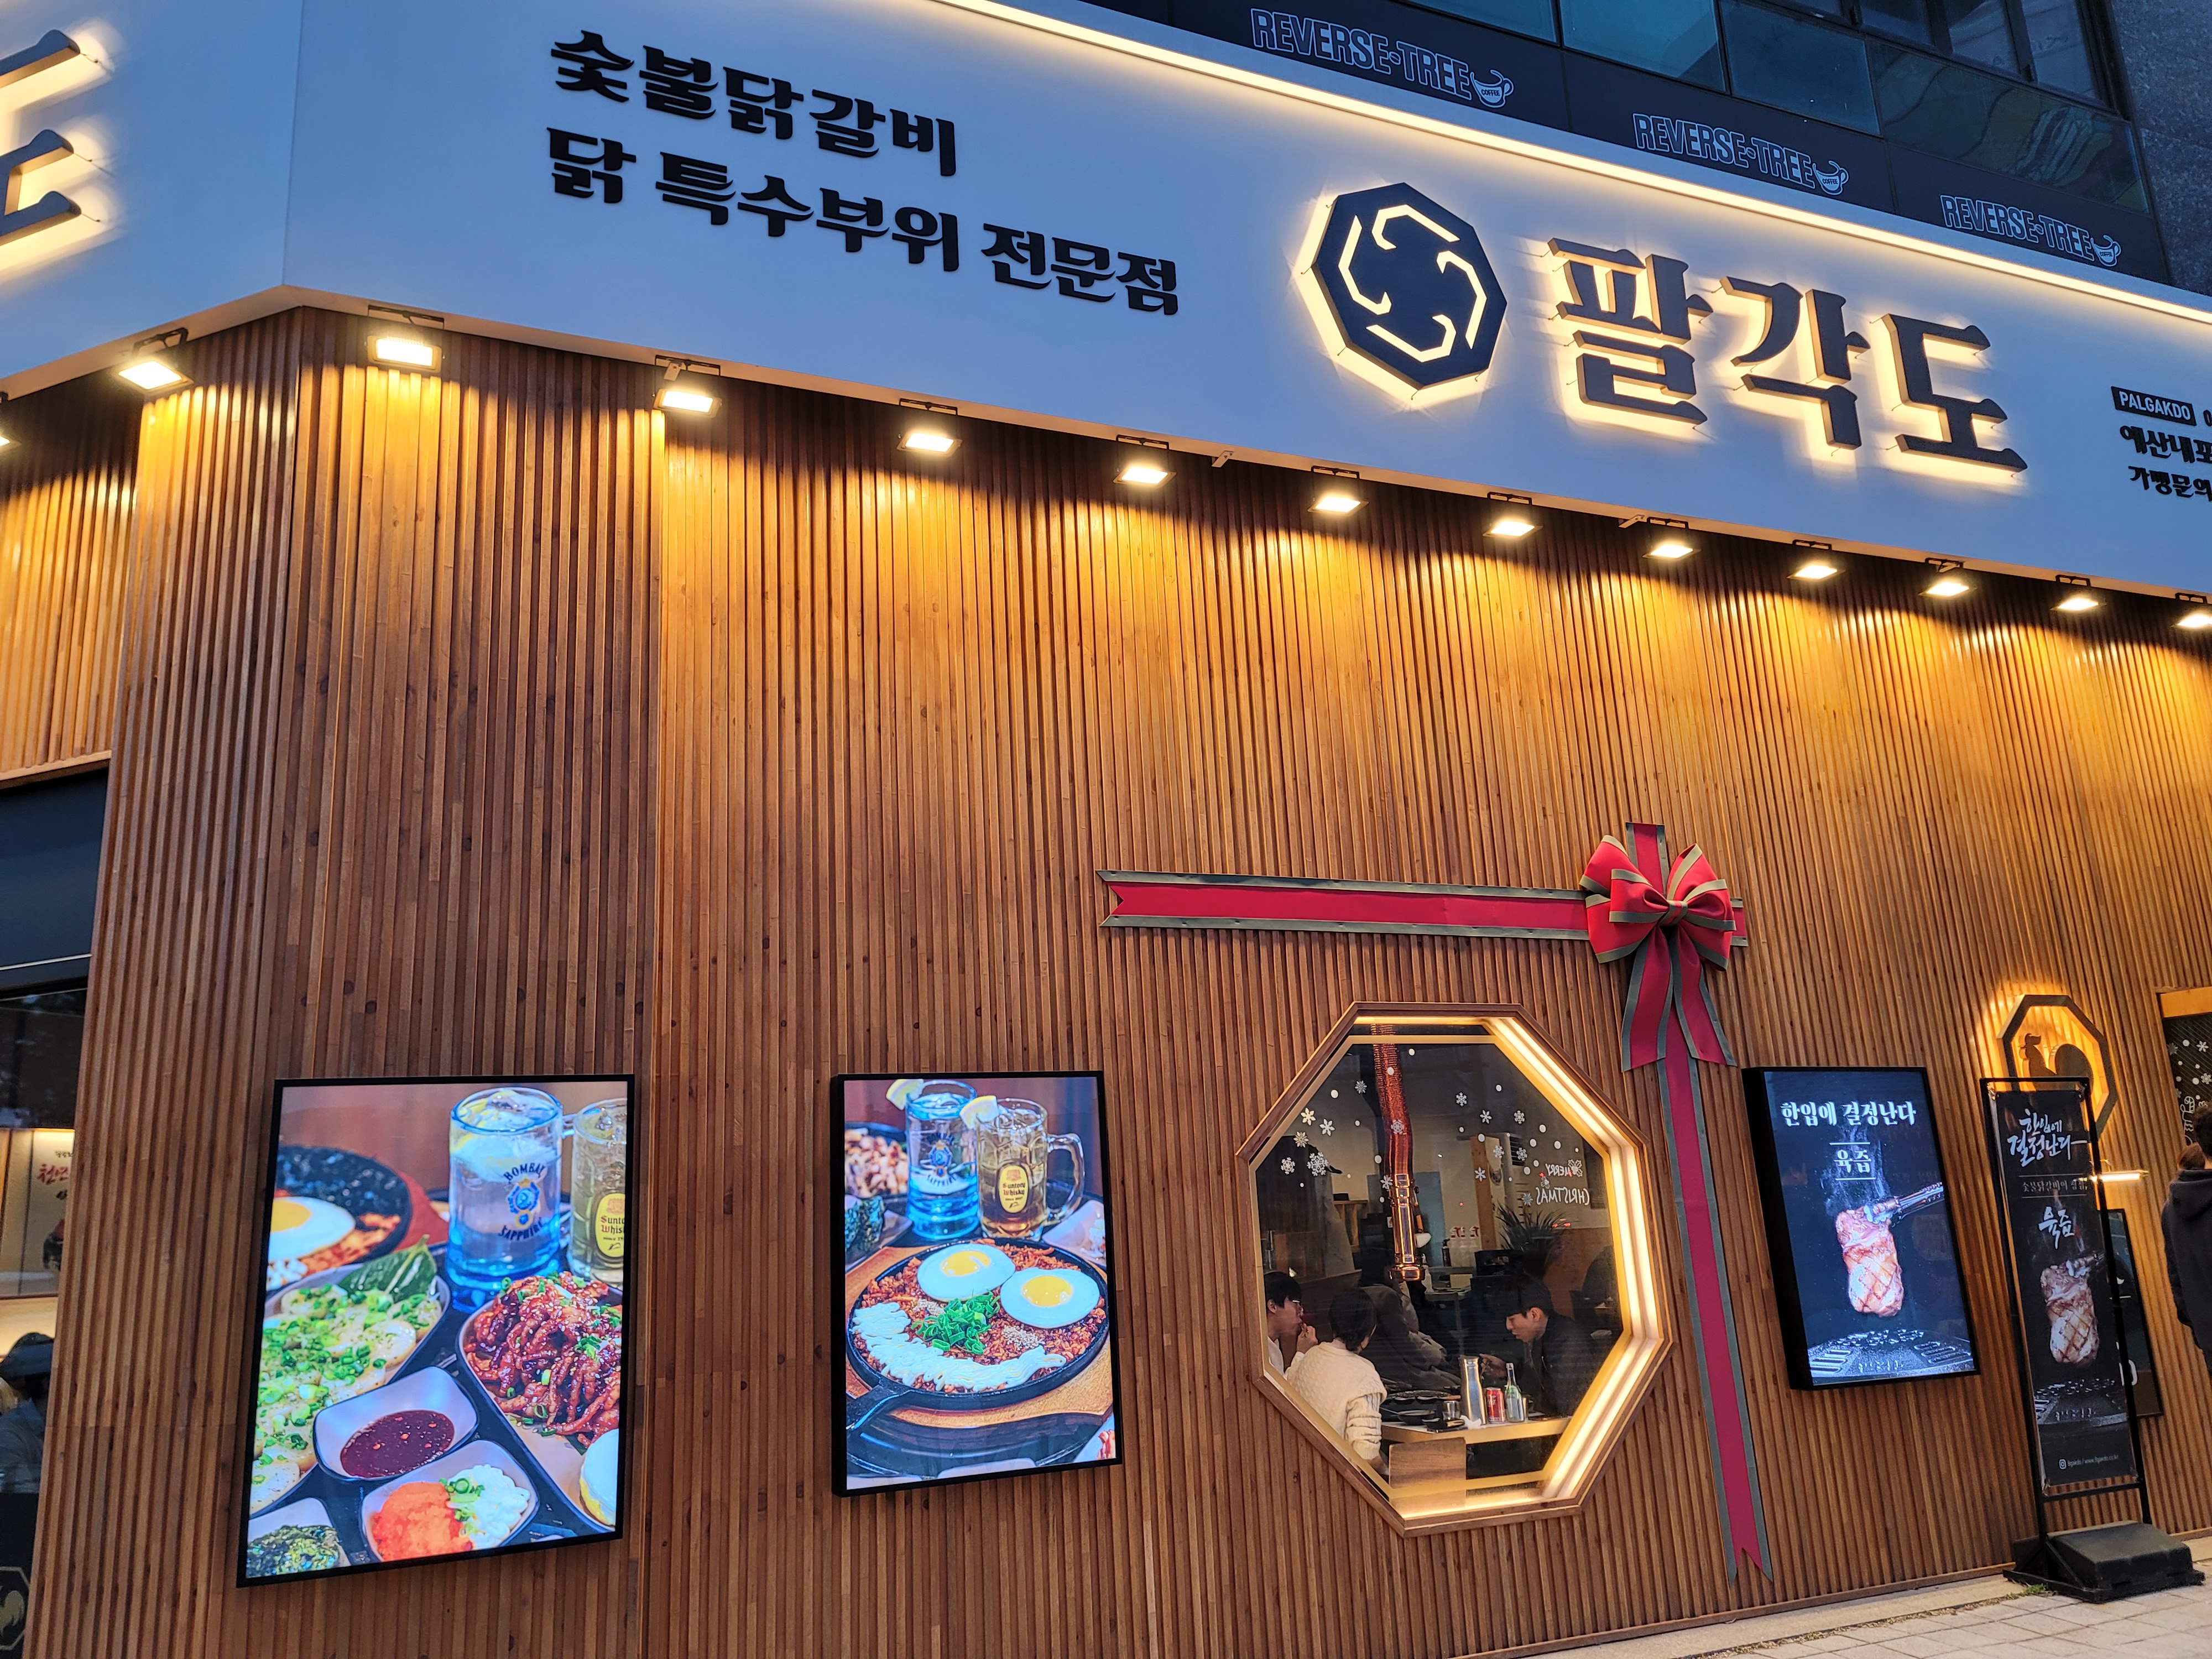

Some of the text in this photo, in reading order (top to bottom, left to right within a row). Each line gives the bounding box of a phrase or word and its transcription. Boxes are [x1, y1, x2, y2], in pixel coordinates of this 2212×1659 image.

[551, 29, 956, 176] 숯불닭갈비
[547, 127, 1179, 315] 닭 특수부위 전문점
[1547, 237, 2028, 473] 팔각도
[2119, 390, 2191, 420] PALGAKDO
[1780, 1101, 1917, 1126] 한입에 결정난다
[2019, 1108, 2063, 1134] 한입에
[1834, 1149, 1872, 1173] 육즙
[2007, 1130, 2088, 1167] 결정난다
[503, 1162, 546, 1184] BOMBAY
[2038, 1207, 2075, 1249] 육즙
